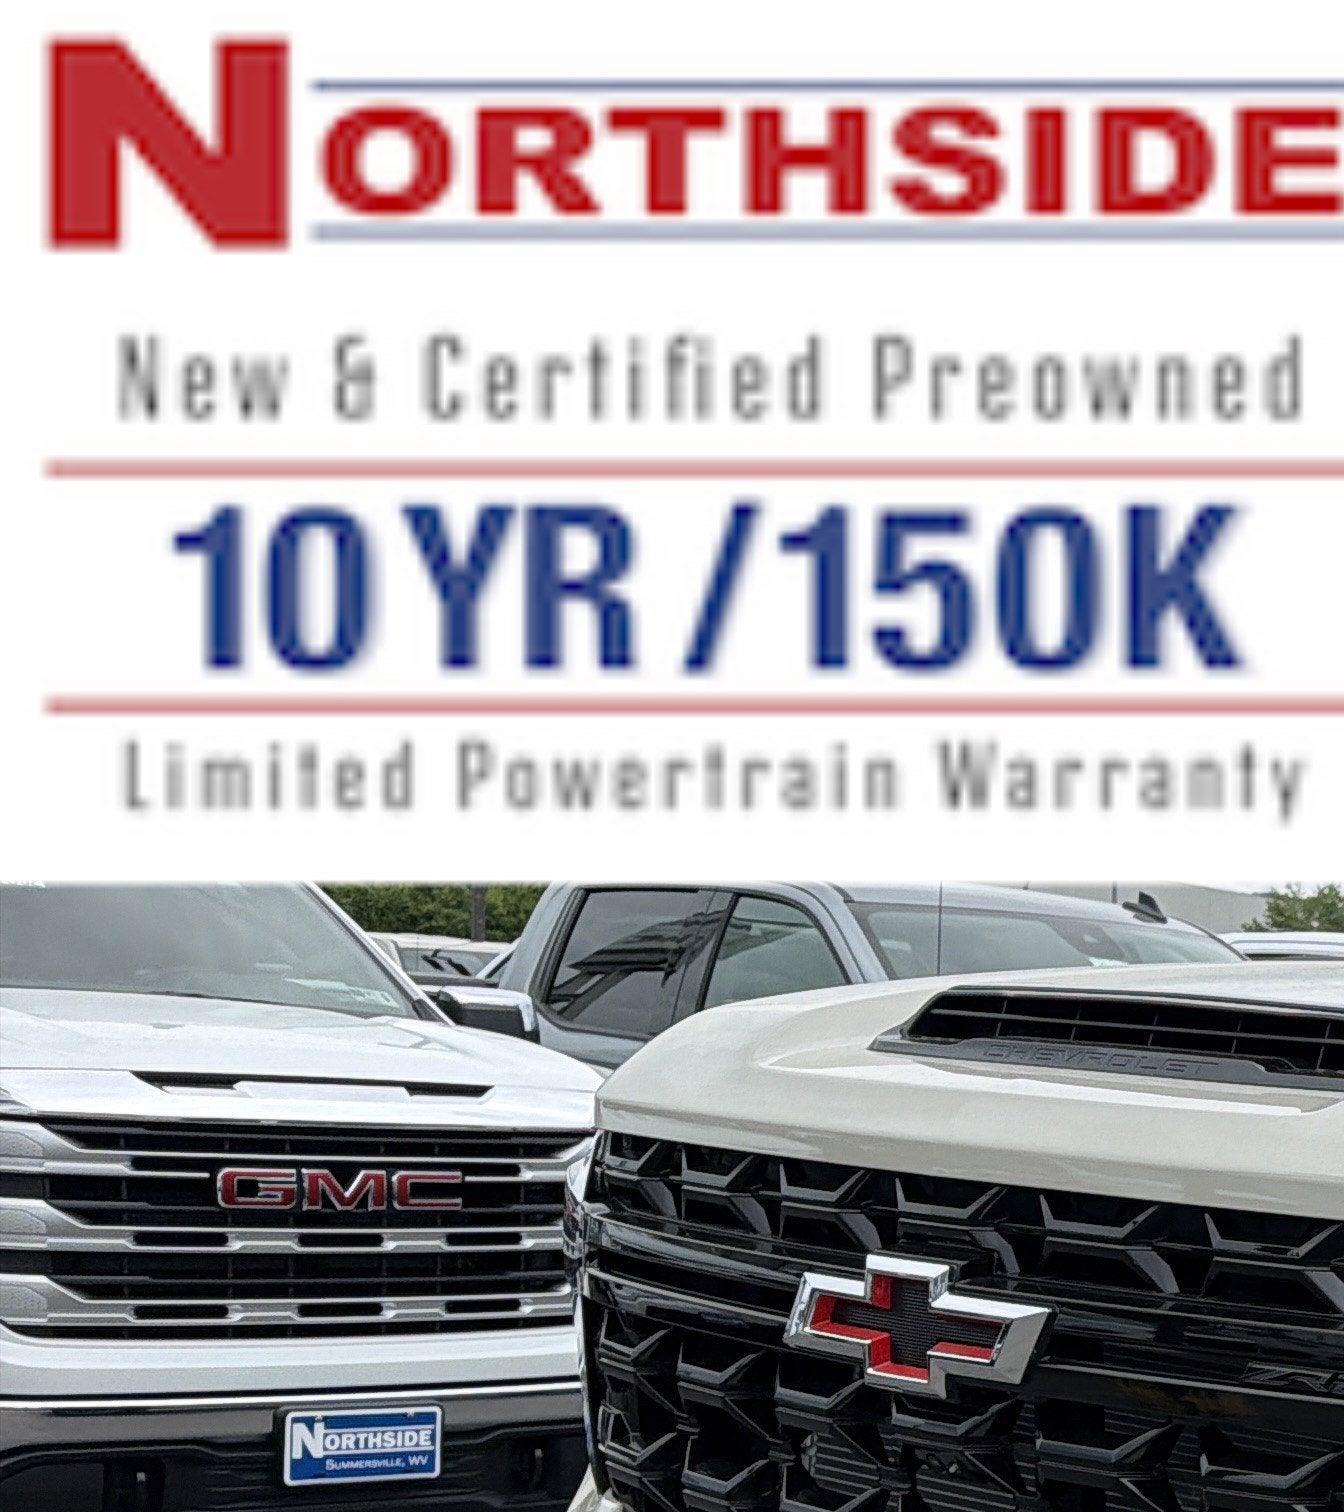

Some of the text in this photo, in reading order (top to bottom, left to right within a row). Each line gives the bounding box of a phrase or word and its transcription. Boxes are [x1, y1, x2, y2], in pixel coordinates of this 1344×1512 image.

[984, 1044, 1219, 1075] CHEVROLET
[216, 1167, 463, 1211] GMC
[292, 1422, 432, 1459] NORTHSIDE
[408, 1454, 429, 1467] WV
